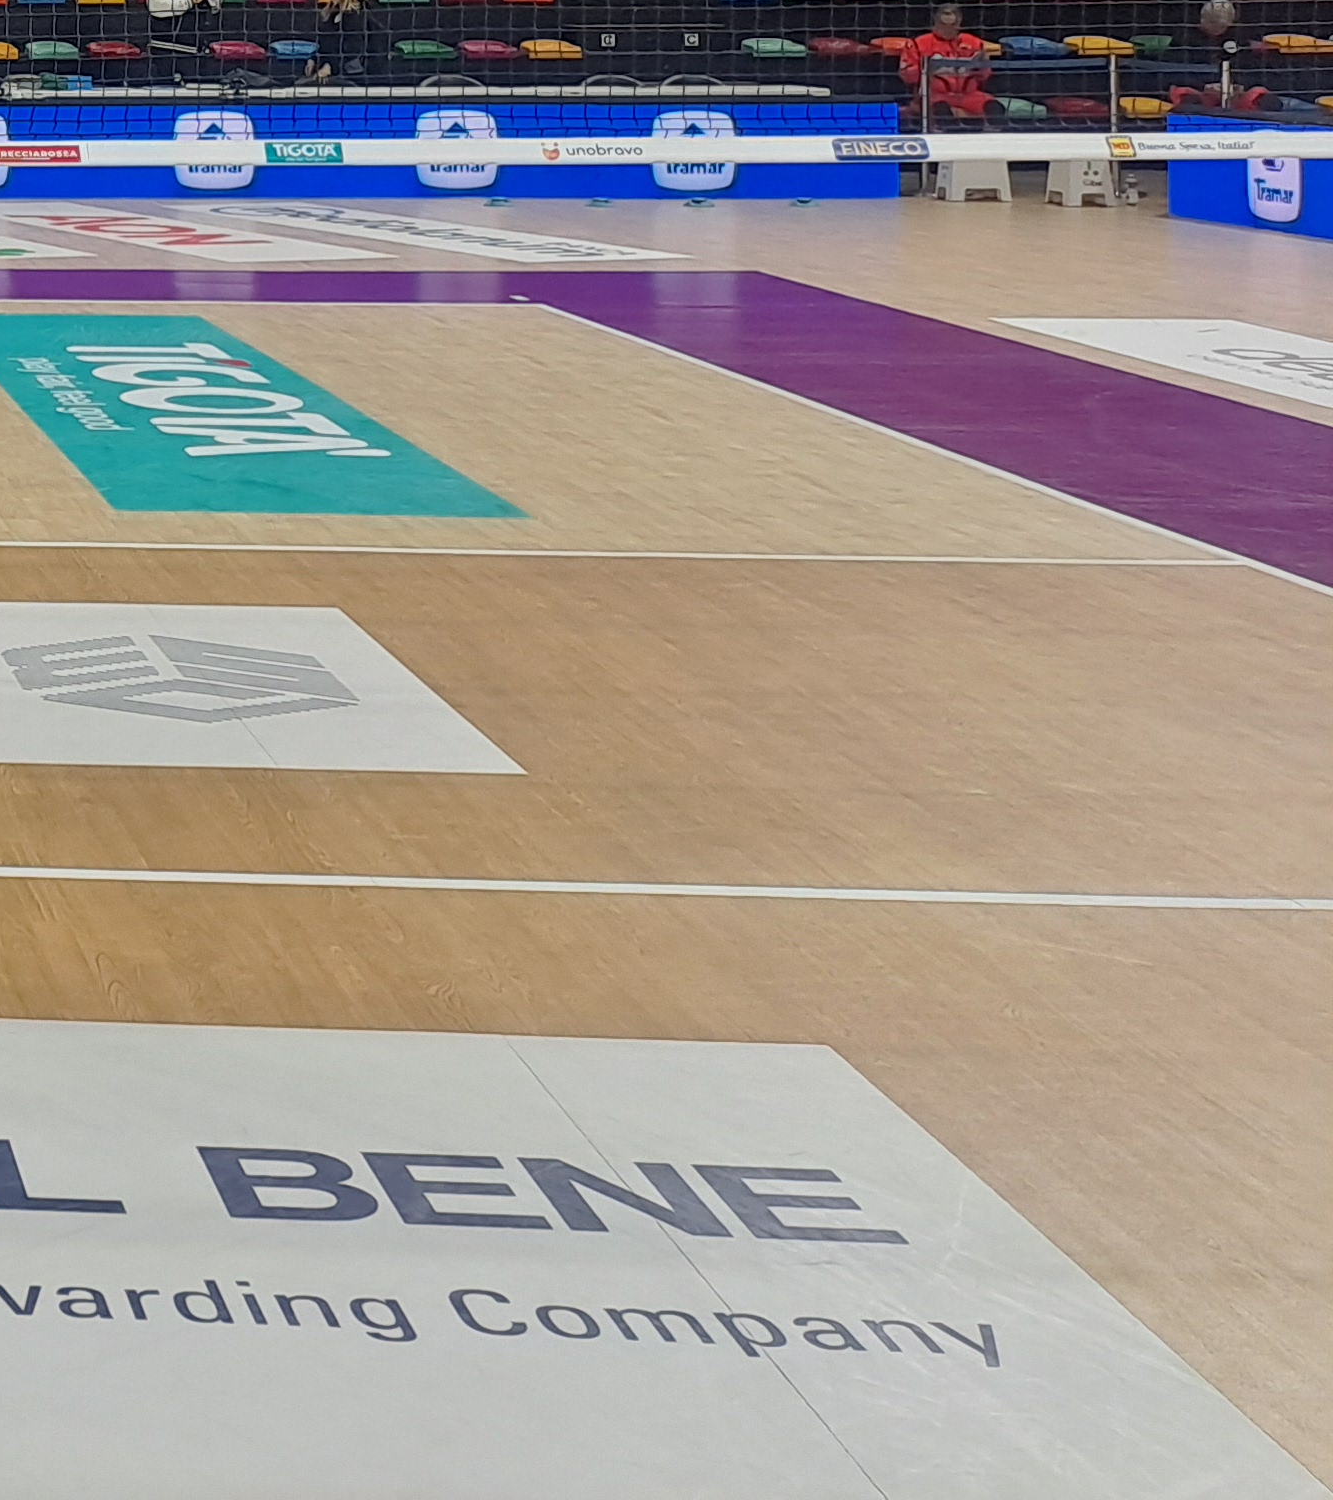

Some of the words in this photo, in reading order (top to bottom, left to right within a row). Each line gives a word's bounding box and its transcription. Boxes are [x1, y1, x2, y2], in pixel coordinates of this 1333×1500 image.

[565, 143, 644, 156] unobravo
[839, 141, 922, 156] FINECO
[1253, 177, 1294, 204] Tramar
[55, 404, 136, 432] good
[195, 1145, 910, 1246] BENE
[447, 1288, 1003, 1369] Company
